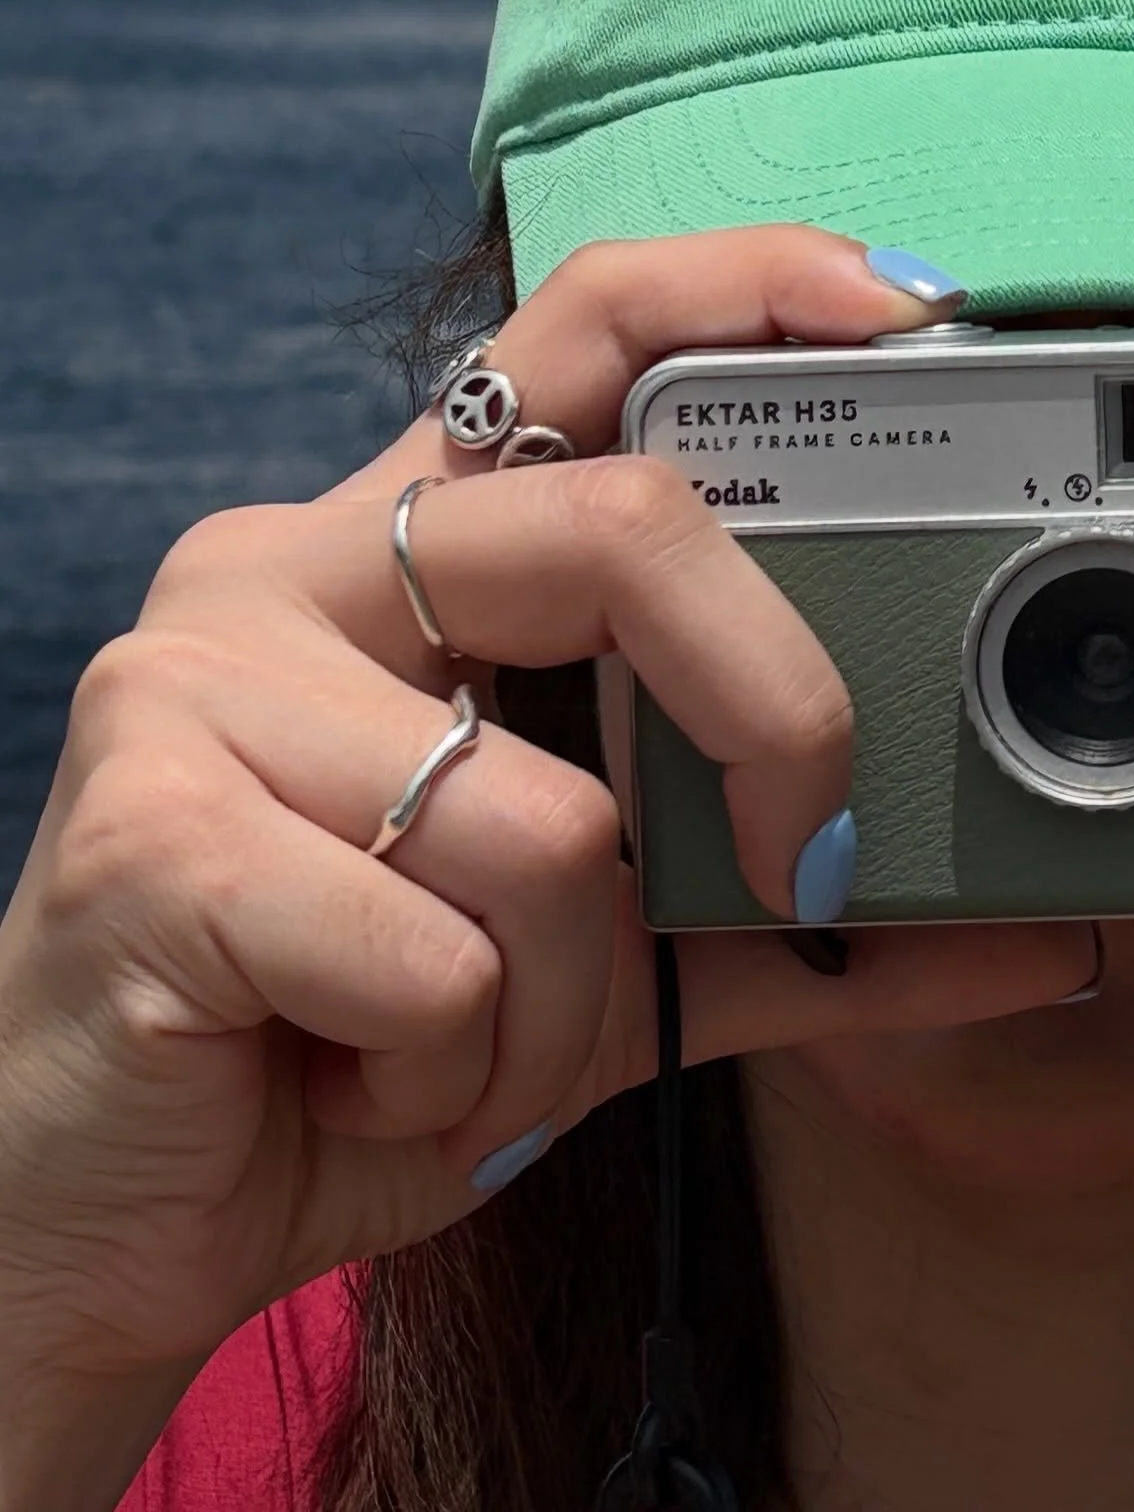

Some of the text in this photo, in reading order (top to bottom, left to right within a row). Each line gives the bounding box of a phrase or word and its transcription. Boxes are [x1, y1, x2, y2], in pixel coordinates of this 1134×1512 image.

[676, 399, 858, 427] EKTAR H35
[677, 429, 952, 453] HALF FRAME CAMERA
